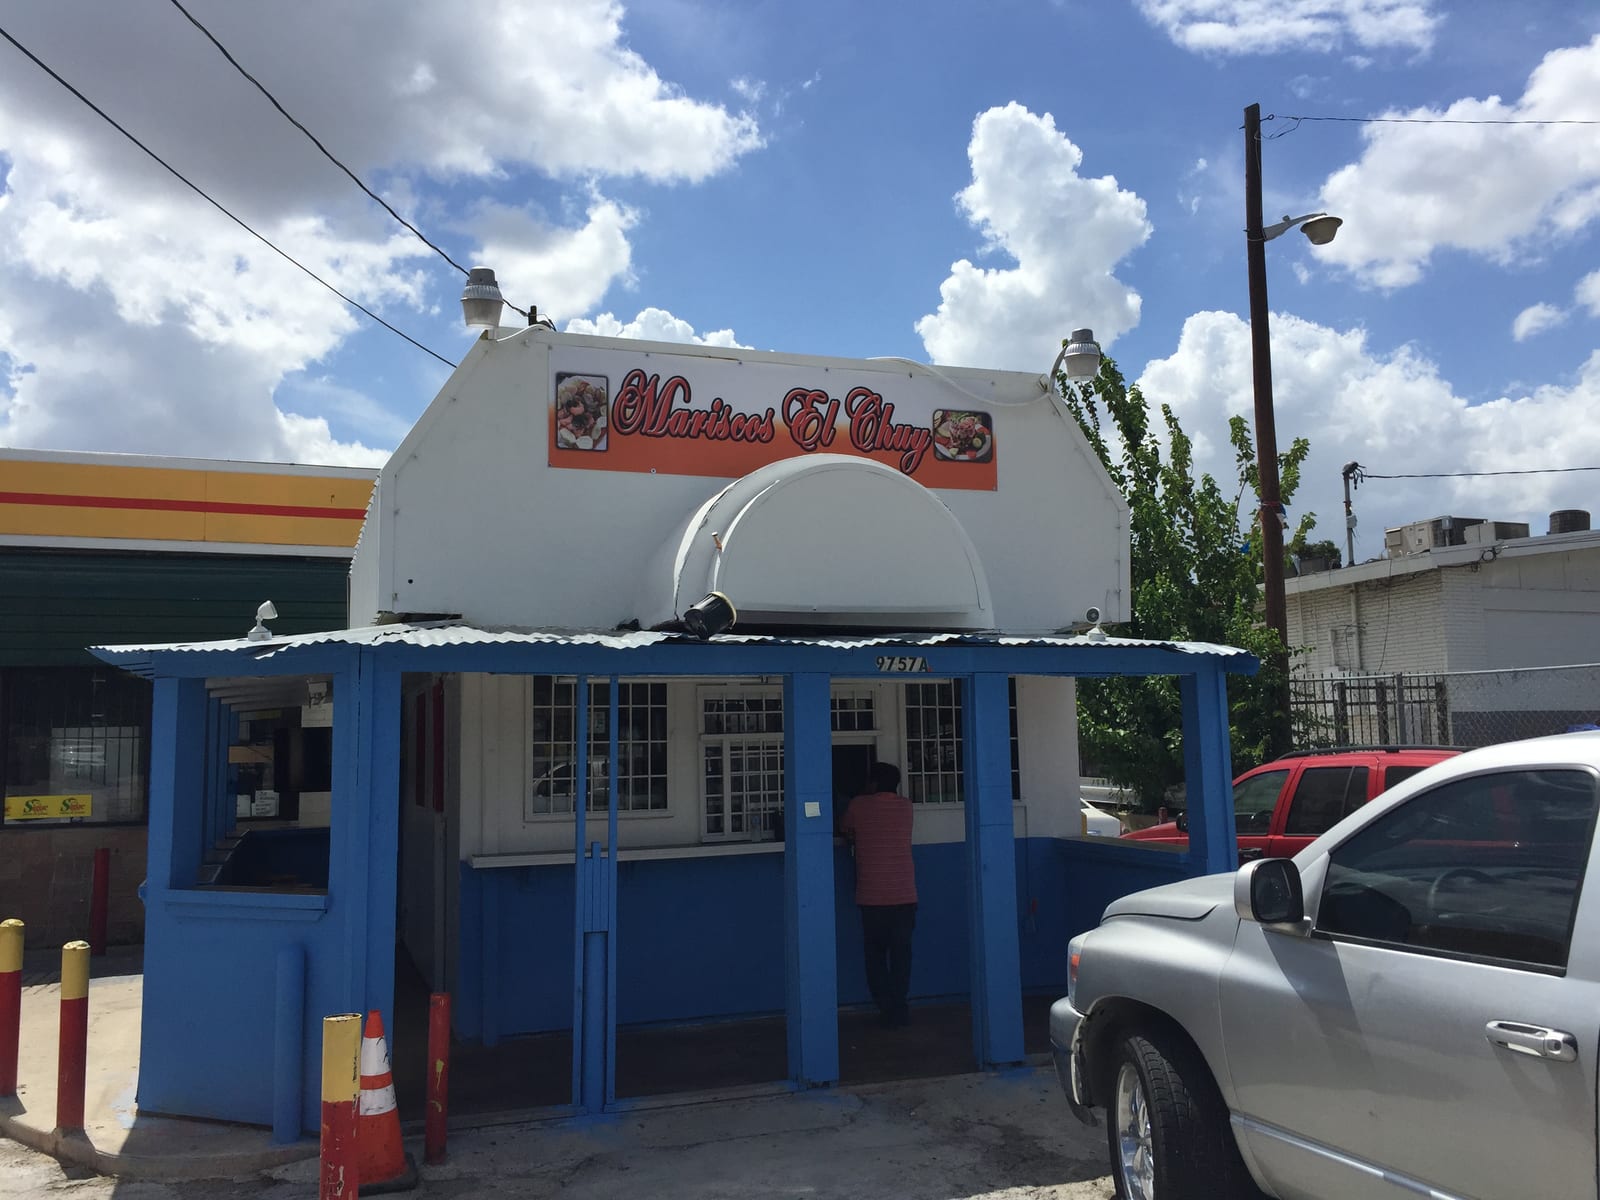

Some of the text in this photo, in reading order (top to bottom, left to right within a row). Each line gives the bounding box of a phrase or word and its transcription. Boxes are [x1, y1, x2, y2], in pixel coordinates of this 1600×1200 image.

[611, 368, 932, 475] Mariscos El Chuy
[876, 656, 928, 672] 9757A
